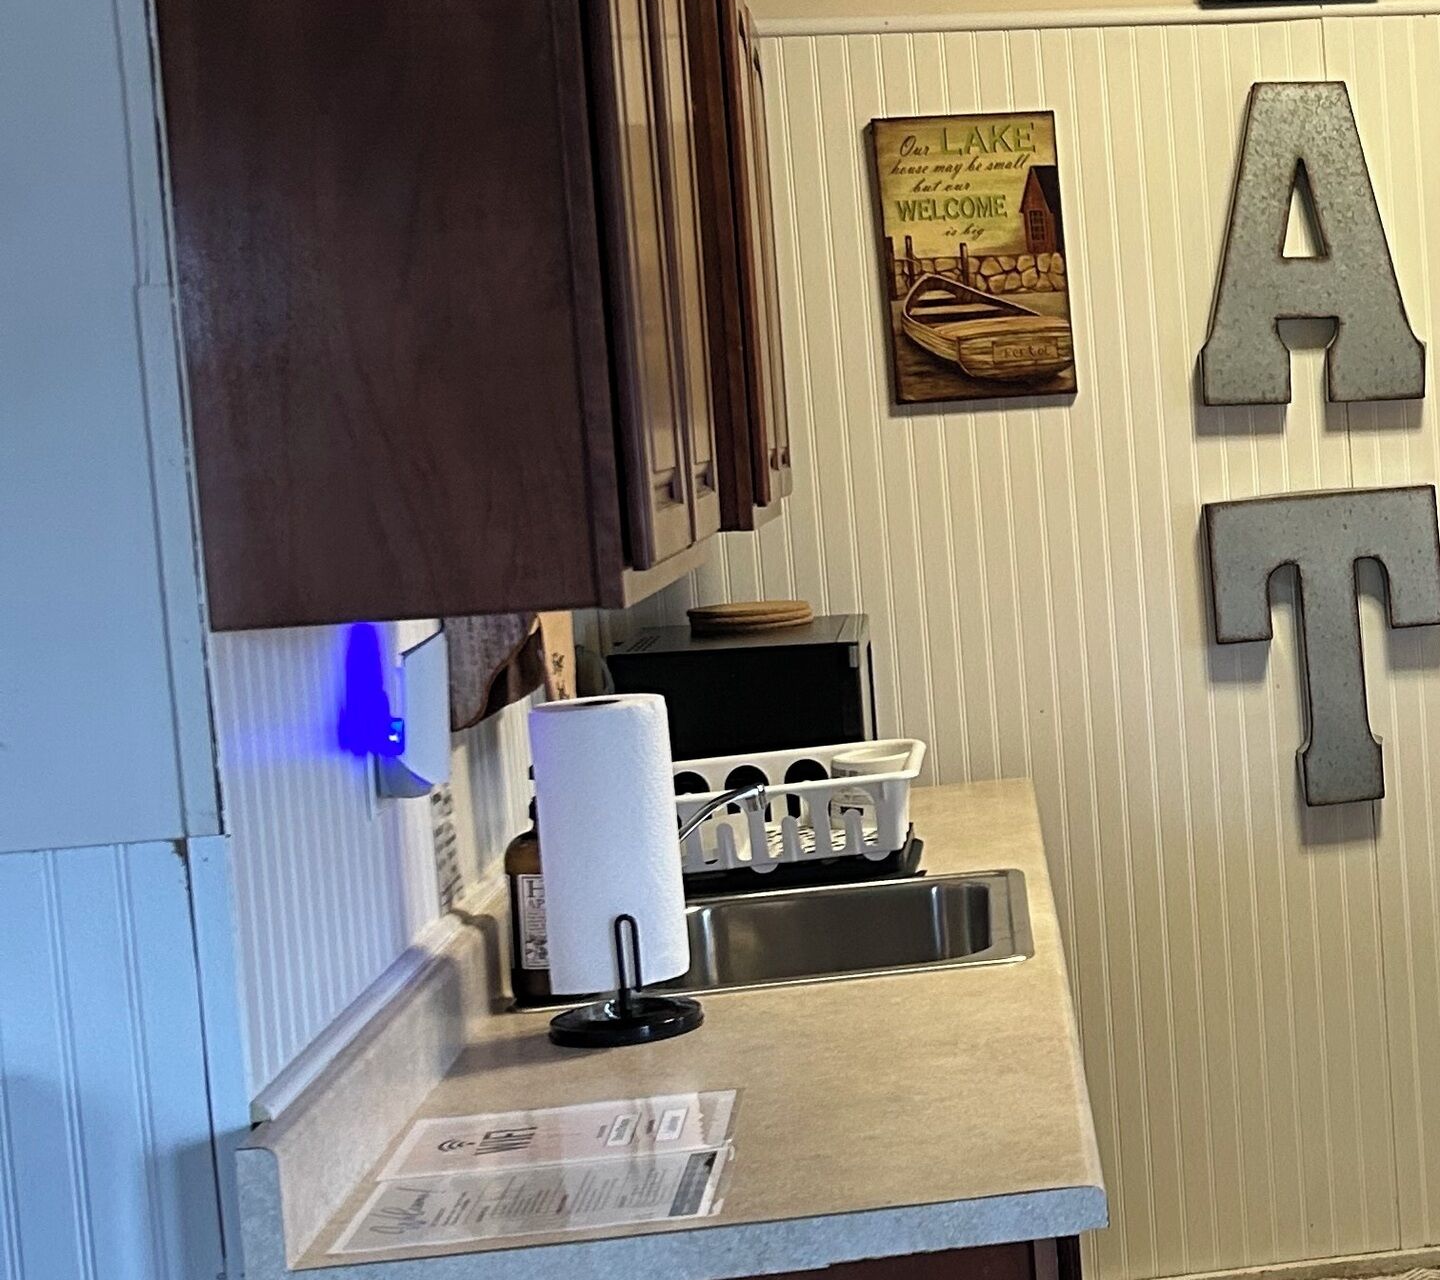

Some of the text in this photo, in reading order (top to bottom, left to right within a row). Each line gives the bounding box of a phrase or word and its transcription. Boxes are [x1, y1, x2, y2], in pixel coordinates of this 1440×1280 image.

[900, 121, 1036, 157] Our LAKE
[890, 153, 1031, 180] house may be small
[912, 178, 942, 193] but
[896, 194, 1008, 222] WELCOME
[944, 223, 985, 240] is big
